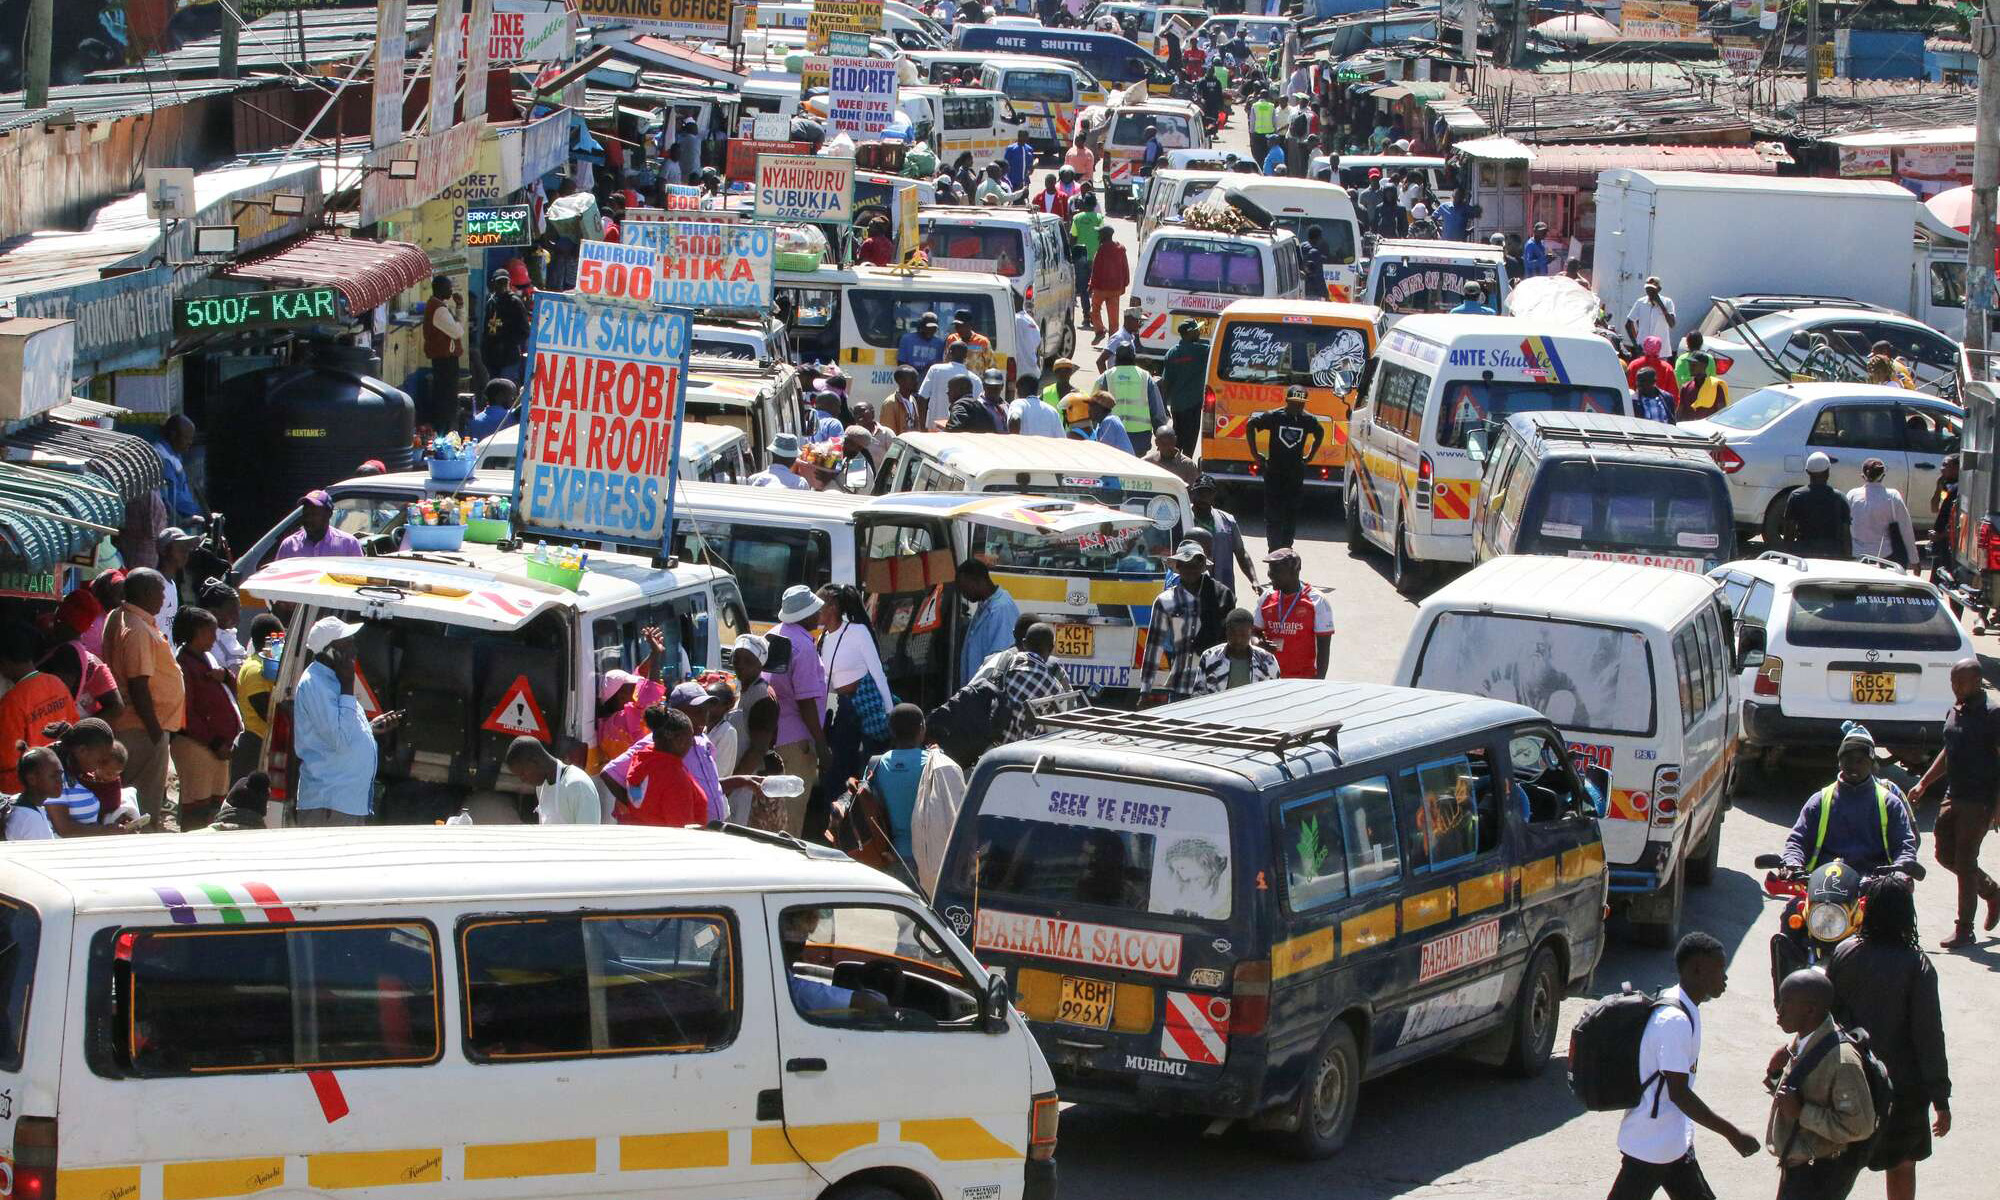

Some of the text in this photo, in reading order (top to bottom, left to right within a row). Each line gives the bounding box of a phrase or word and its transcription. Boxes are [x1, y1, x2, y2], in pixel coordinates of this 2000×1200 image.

[670, 0, 727, 21] OFFICE
[996, 36, 1093, 52] 4NTE SHUTTLE
[833, 58, 896, 69] MOLINE LUXURY
[832, 67, 895, 94] ELDORET
[836, 98, 888, 111] WEBUYE
[762, 166, 846, 192] NYAHURURU
[432, 186, 500, 201] OOKING
[667, 194, 700, 211] 500
[762, 189, 841, 211] SUBUKIA
[501, 210, 528, 220] SHOP
[776, 207, 825, 218] DIRECT
[583, 242, 656, 267] NAIROBI
[674, 235, 722, 256] 500
[656, 254, 756, 282] HIKA
[579, 261, 653, 301] 500
[1181, 296, 1212, 309] HIGHWAY
[1386, 273, 1425, 312] POWER
[187, 290, 335, 328] 500/- KAR
[537, 300, 686, 359] 2NK SACCO
[1450, 348, 1552, 368] 4NTE Shuttle
[530, 352, 679, 421] NAIROBI
[528, 408, 672, 478] TEA ROOM
[529, 464, 659, 532] EXPRESS
[1868, 595, 1886, 604] SALE
[1064, 626, 1091, 641] KCT
[1057, 640, 1090, 656] 315T
[1064, 664, 1131, 687] HUTTLE
[1855, 675, 1885, 689] KBC
[1049, 790, 1172, 828] SEEK YE FIRST
[976, 911, 1179, 973] BAHAMA SACCO
[1421, 922, 1498, 979] BAHAMA SACCO
[1073, 979, 1108, 1004] KBH
[1061, 1000, 1105, 1025] 996X
[1125, 1055, 1188, 1077] MUHIMU
